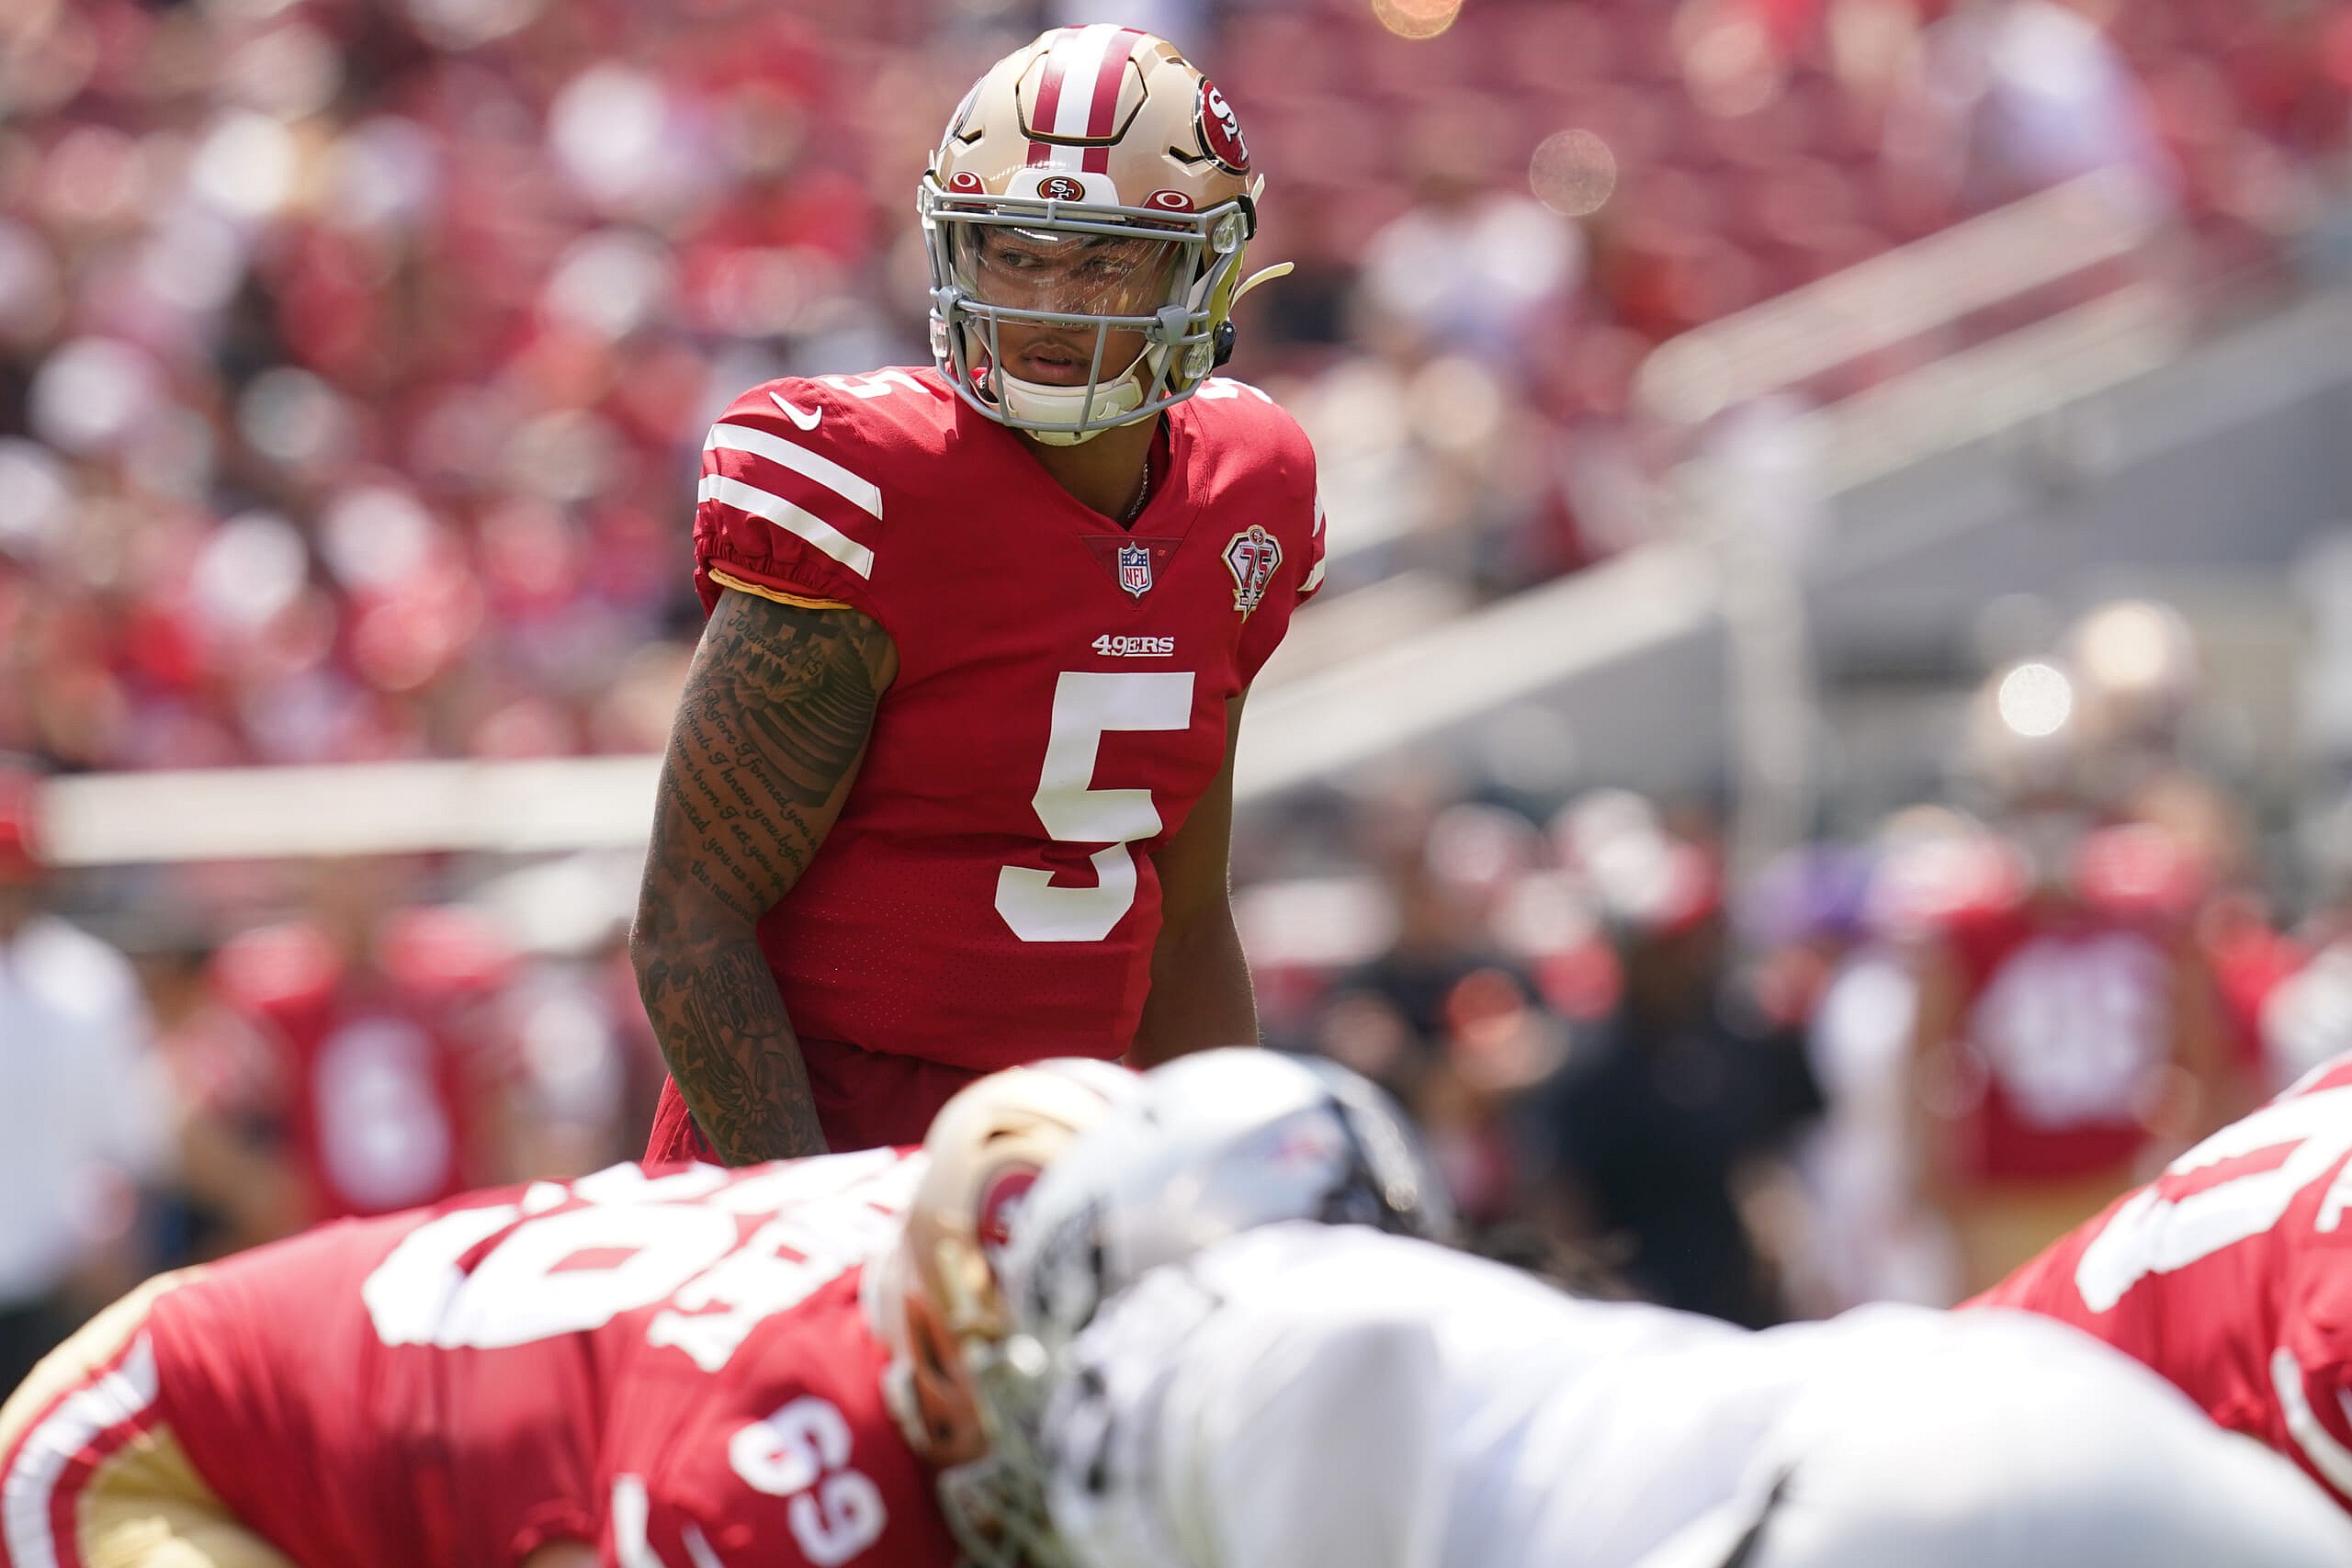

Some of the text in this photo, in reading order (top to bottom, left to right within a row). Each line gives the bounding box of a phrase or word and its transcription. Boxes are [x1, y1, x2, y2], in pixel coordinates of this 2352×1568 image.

[1124, 567, 1148, 586] NFL
[1240, 546, 1272, 593] 75
[1091, 634, 1175, 657] 49ERS
[995, 671, 1195, 942] 5
[729, 1396, 888, 1567] 69
